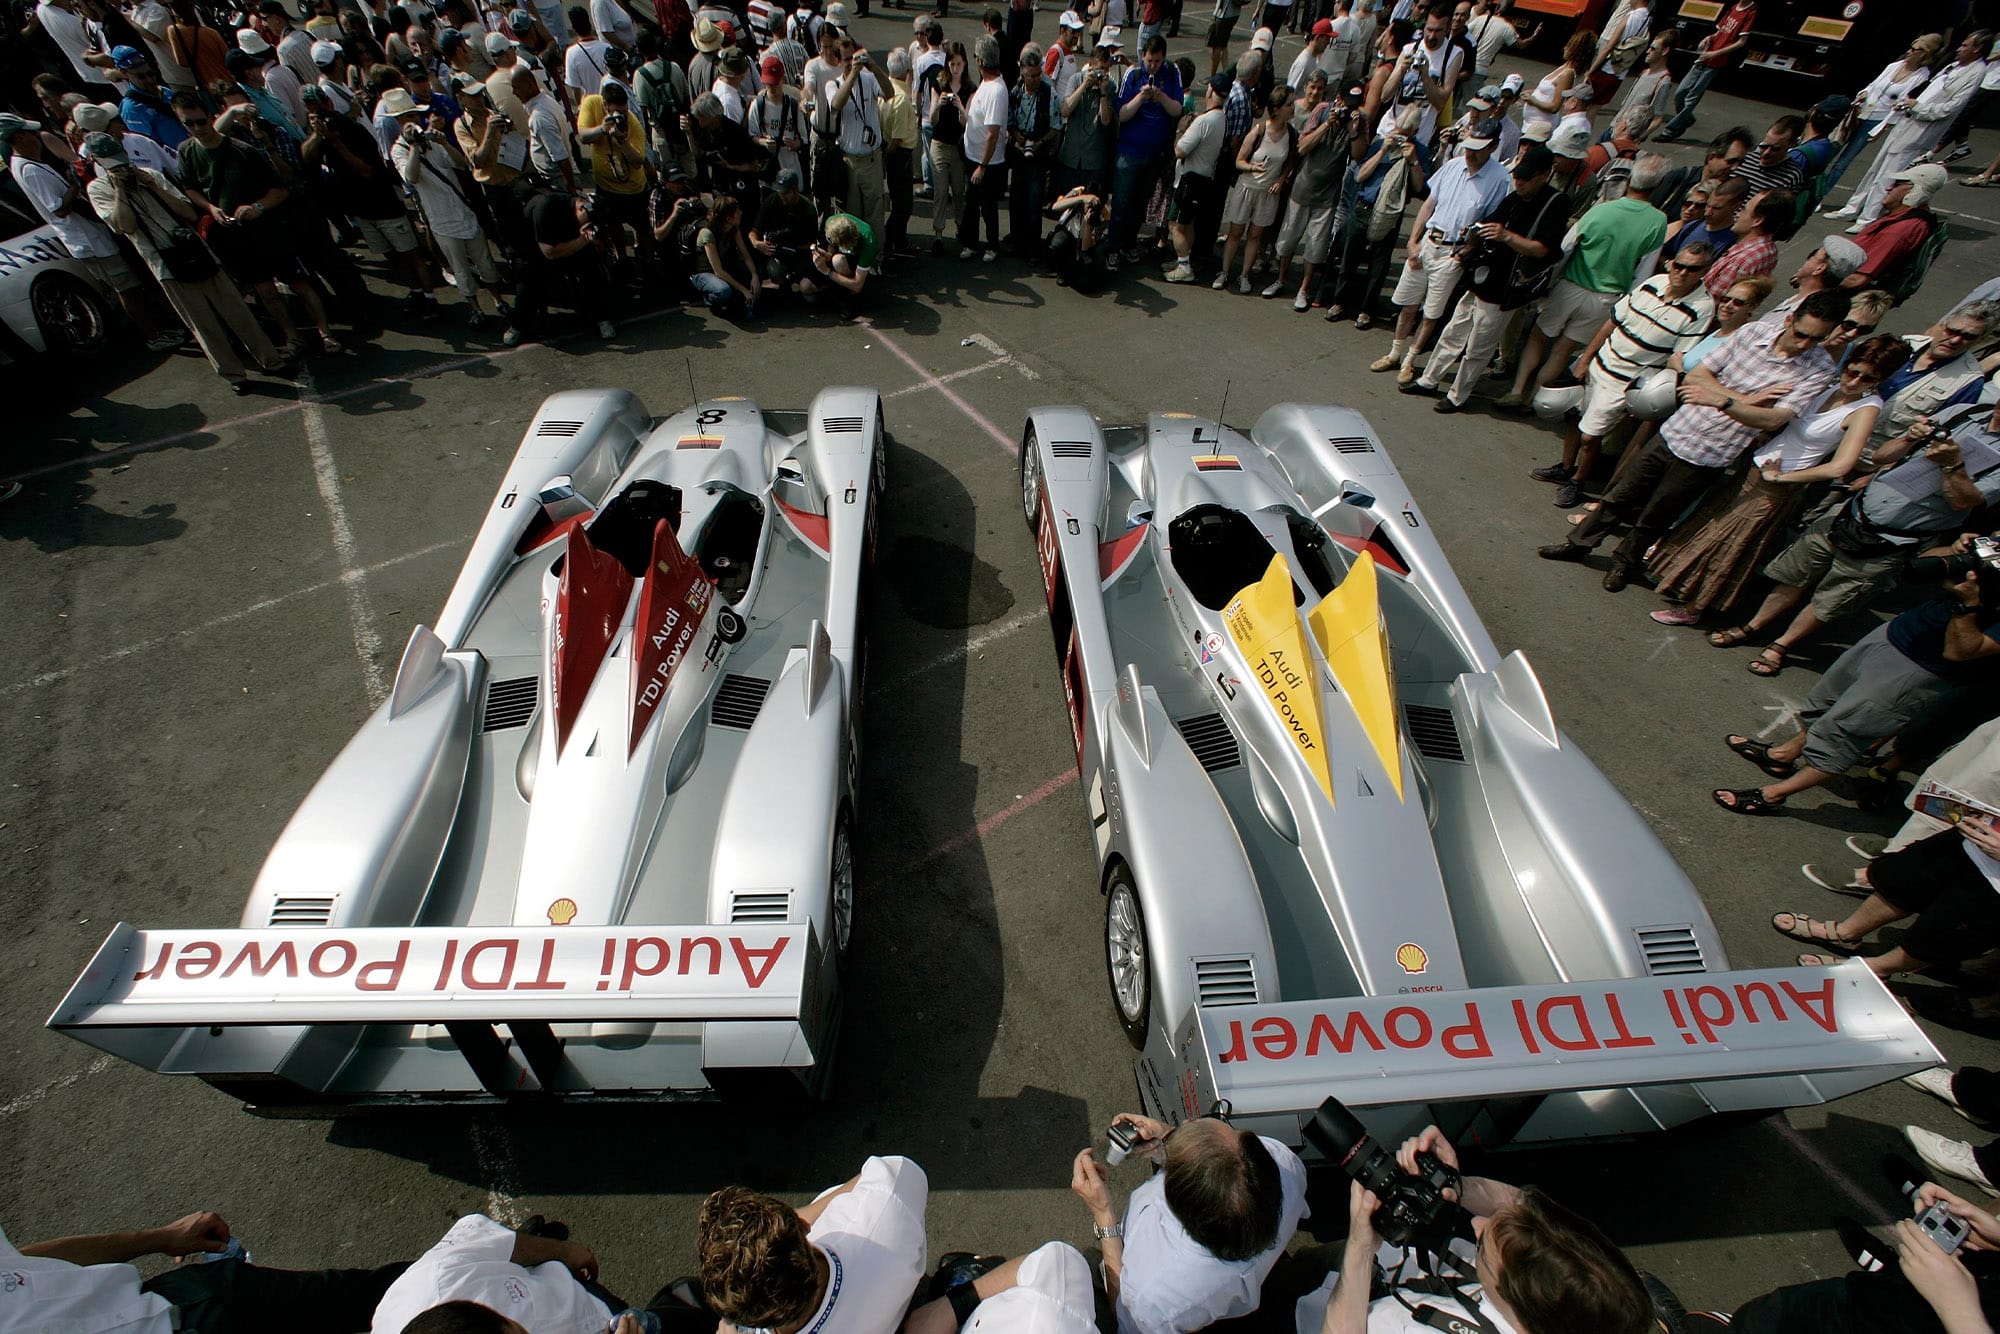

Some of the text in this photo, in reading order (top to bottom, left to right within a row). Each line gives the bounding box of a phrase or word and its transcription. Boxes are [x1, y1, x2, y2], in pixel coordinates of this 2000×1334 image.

[696, 409, 727, 424] 8
[1192, 427, 1219, 443] 7
[1041, 498, 1056, 577] TDI
[652, 607, 680, 650] Audi
[638, 621, 693, 708] TDI Power
[1270, 650, 1303, 690] Audi
[1256, 658, 1316, 751] TDI Power
[134, 936, 788, 991] Audi TDI Power
[1411, 985, 1444, 994] BOSCH
[1218, 979, 1838, 1062] Audi TDI Power
